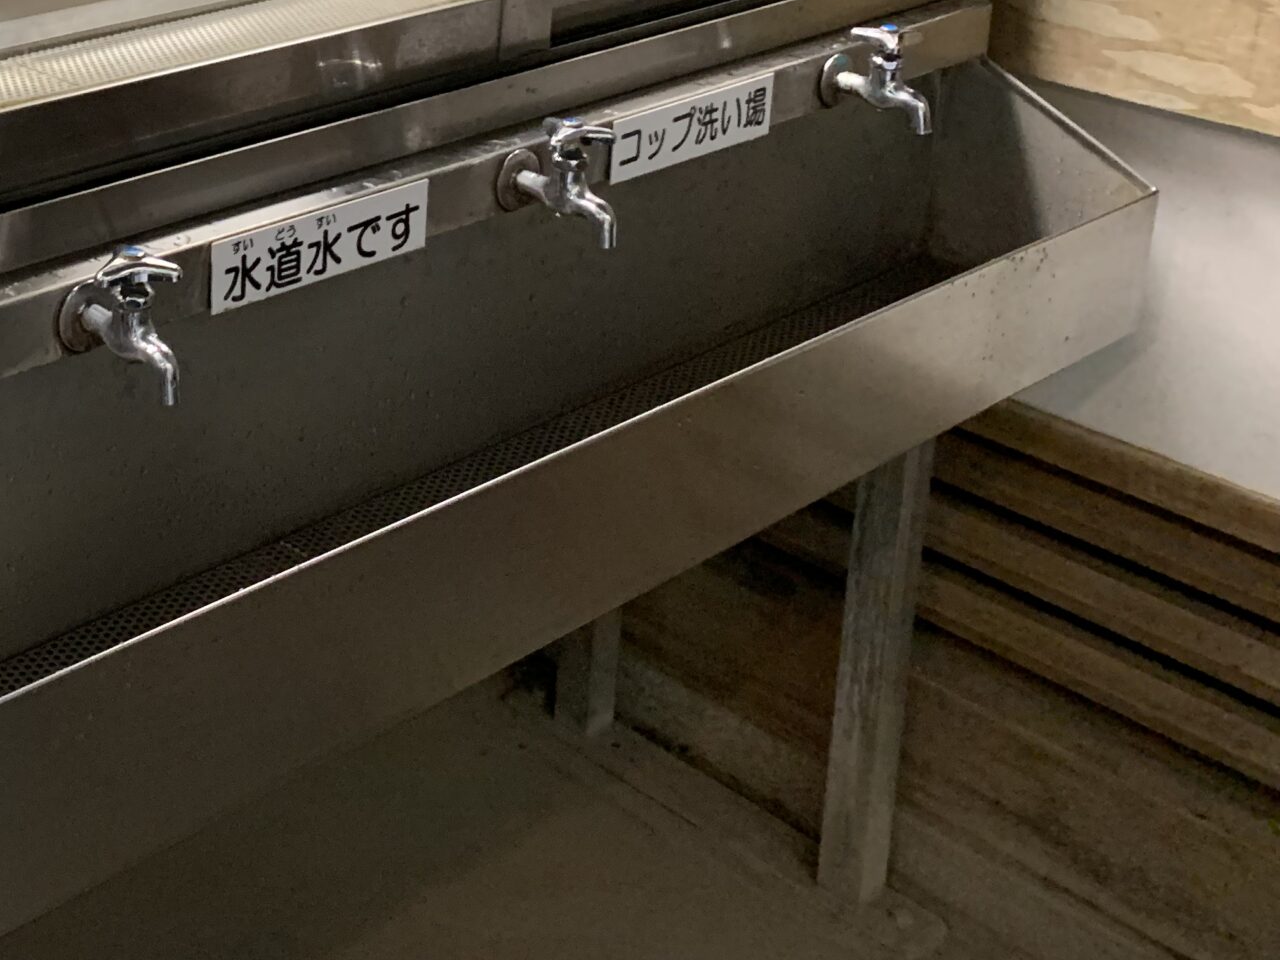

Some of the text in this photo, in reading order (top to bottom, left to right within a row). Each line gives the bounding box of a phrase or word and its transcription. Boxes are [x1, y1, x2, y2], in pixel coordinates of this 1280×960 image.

[618, 86, 767, 167] コップ洗い場
[223, 203, 420, 302] 水道水です
